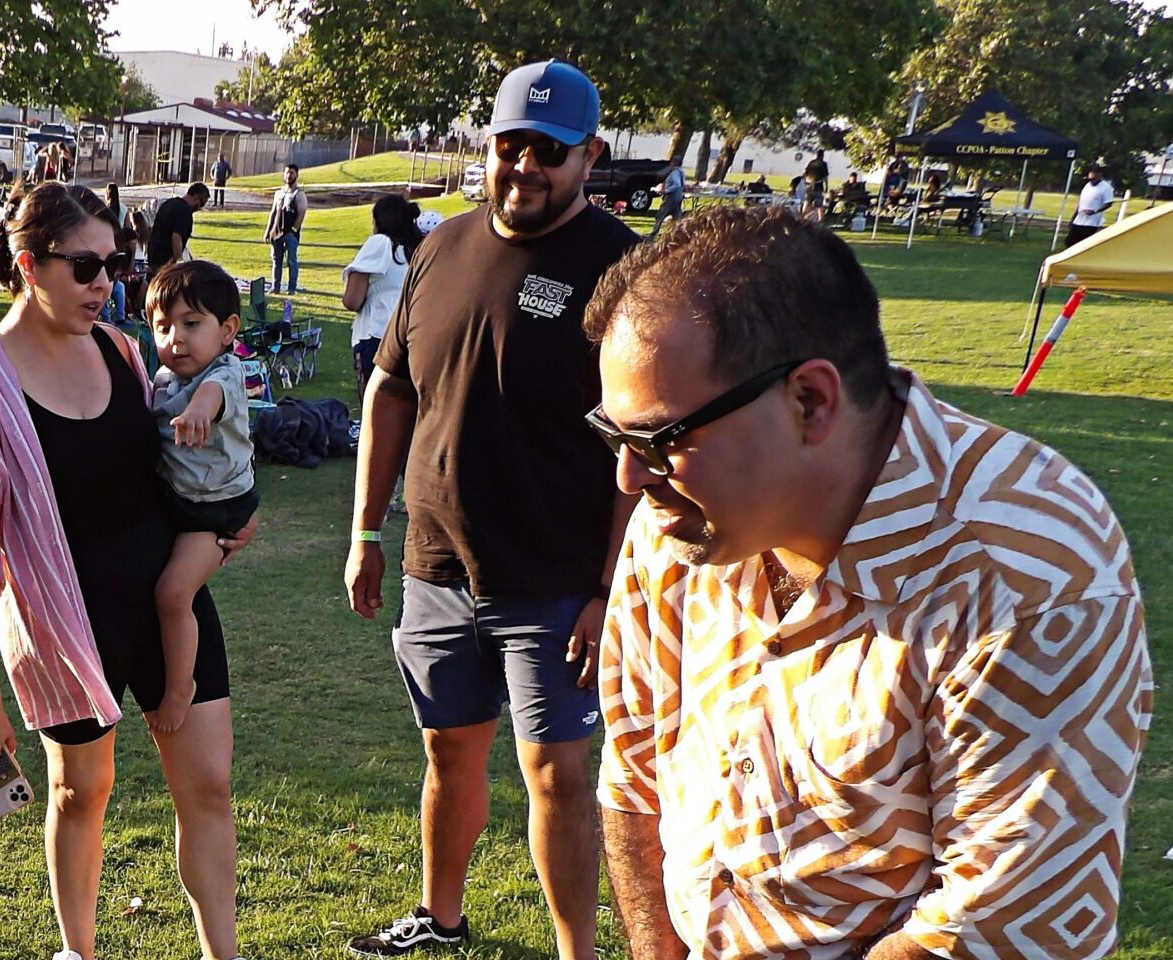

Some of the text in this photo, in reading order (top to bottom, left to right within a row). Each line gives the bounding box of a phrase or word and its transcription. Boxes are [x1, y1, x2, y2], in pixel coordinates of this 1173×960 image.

[955, 145, 984, 154] CCPOA
[989, 145, 1015, 154] Patton
[1016, 146, 1049, 157] Chapter
[523, 278, 573, 304] FAST
[518, 292, 567, 317] HOUSE
